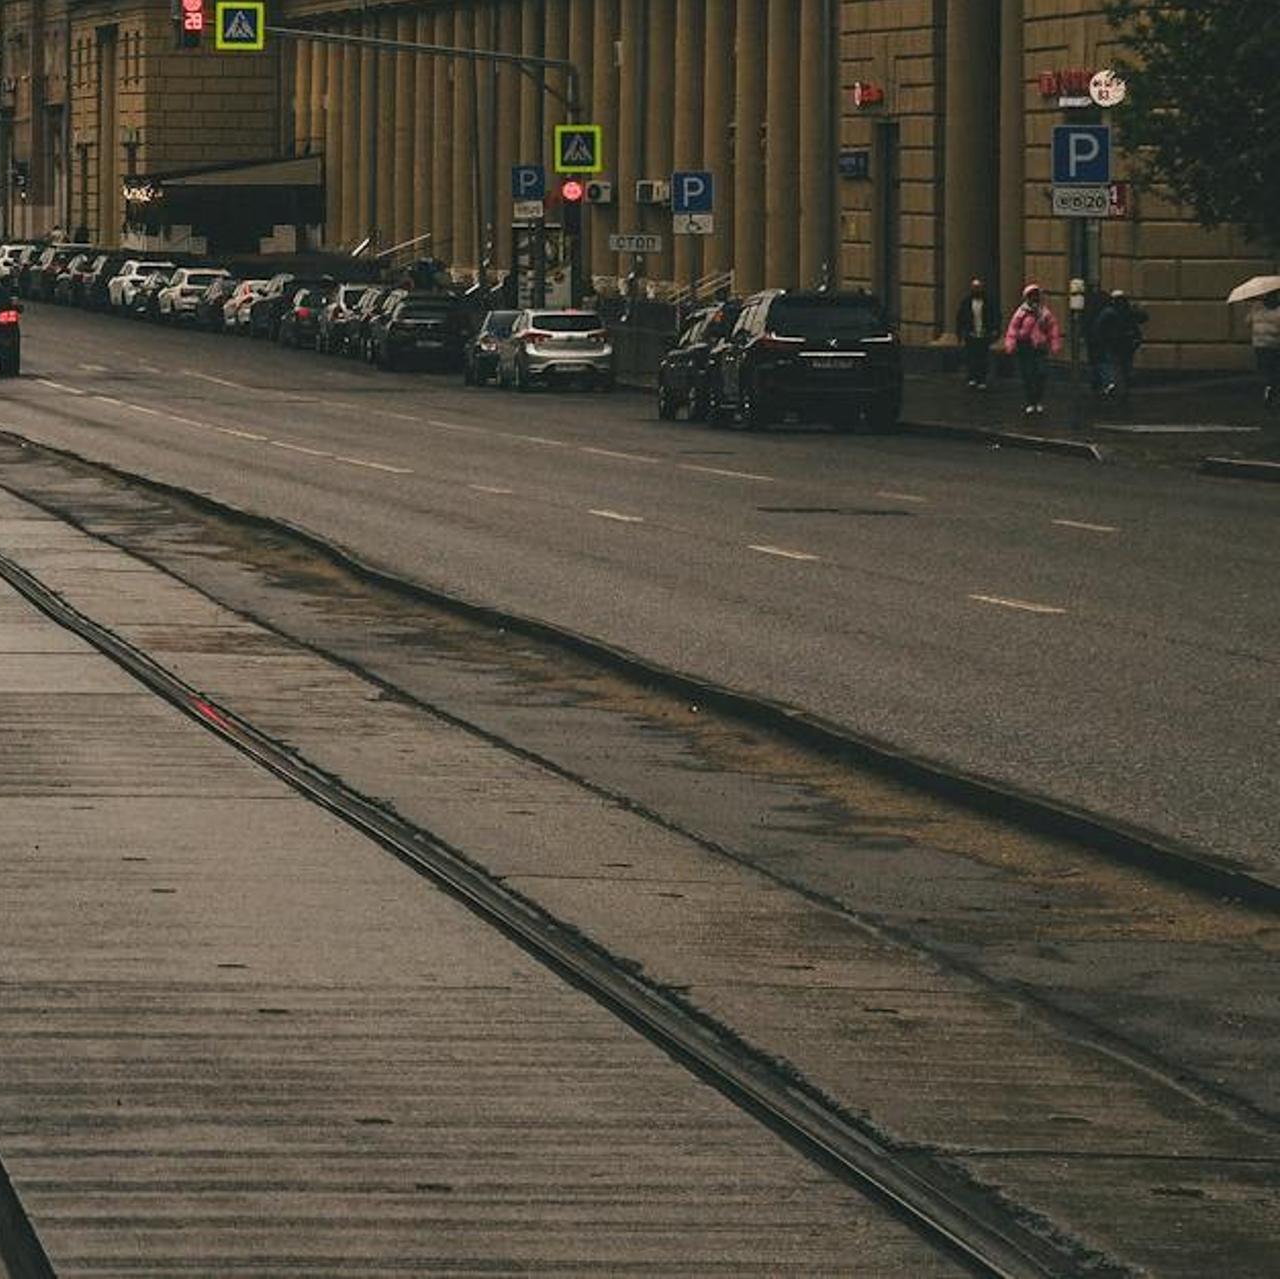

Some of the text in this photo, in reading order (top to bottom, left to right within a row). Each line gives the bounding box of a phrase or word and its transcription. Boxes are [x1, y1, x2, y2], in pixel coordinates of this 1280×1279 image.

[184, 12, 202, 30] 28
[1069, 132, 1100, 177] P
[519, 169, 538, 195] P
[683, 177, 704, 207] P
[616, 236, 656, 249] СТОП
